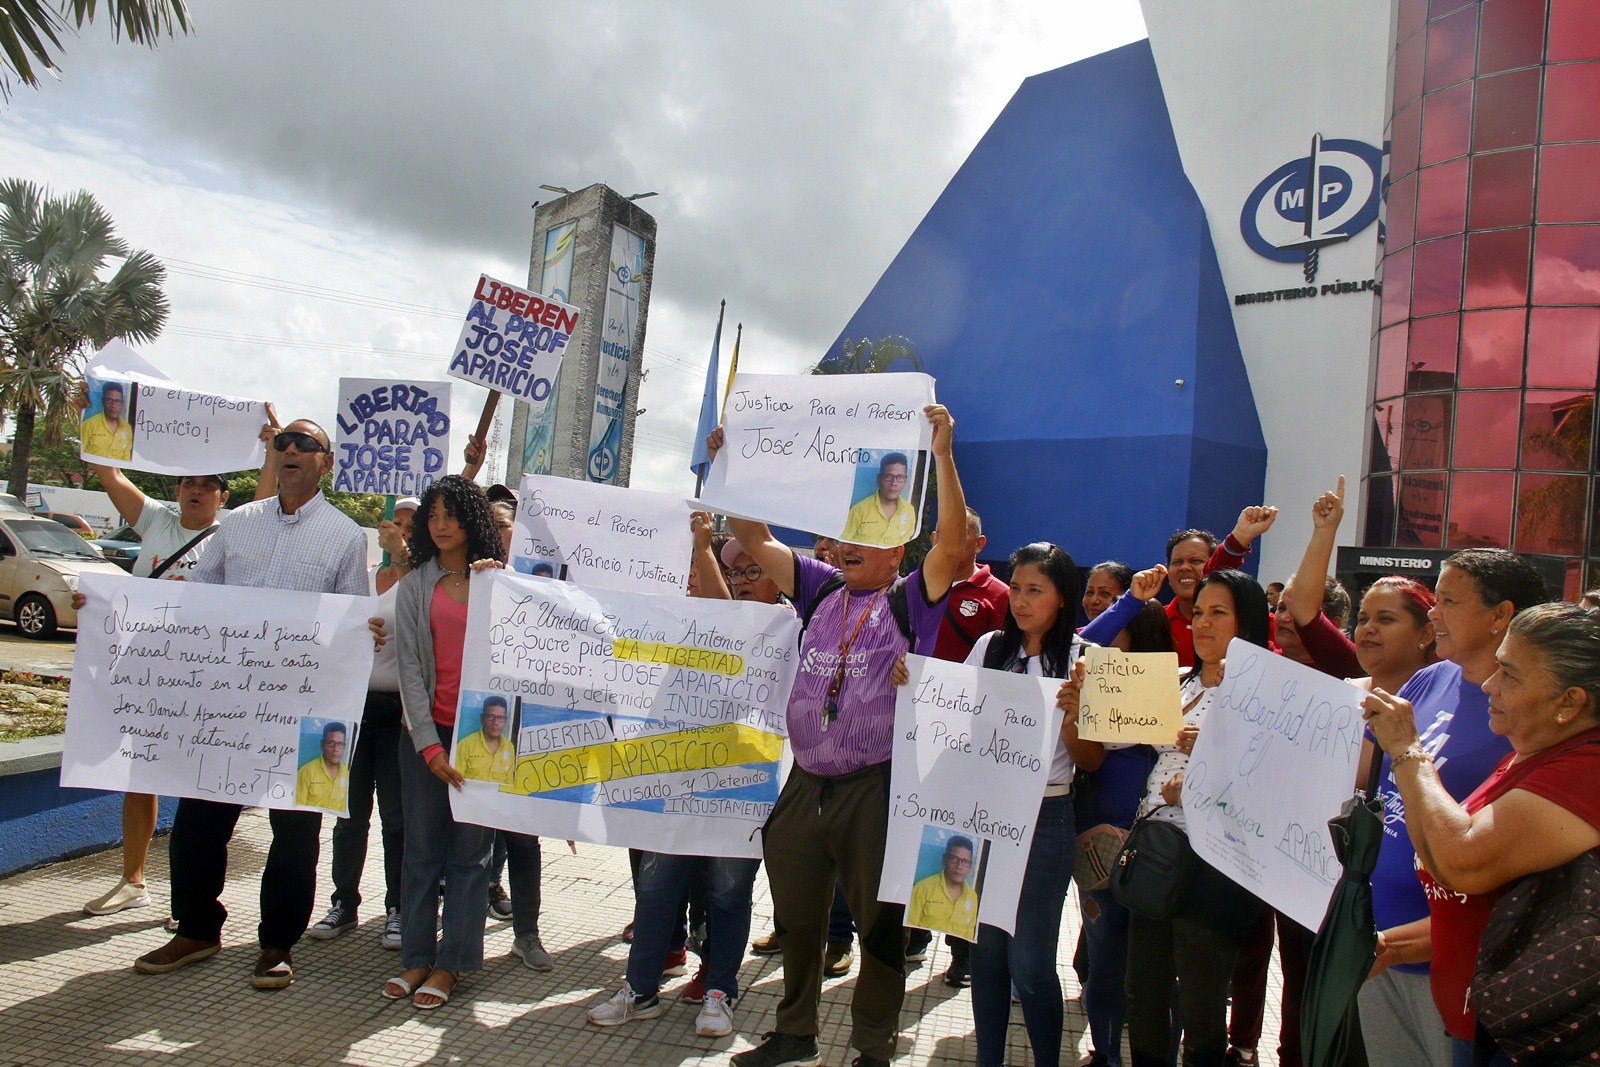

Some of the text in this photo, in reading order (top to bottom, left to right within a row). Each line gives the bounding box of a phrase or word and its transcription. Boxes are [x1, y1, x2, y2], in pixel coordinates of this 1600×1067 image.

[474, 277, 579, 335] LIBEREN
[1235, 279, 1376, 306] MINISTERIO PÚBLIC
[466, 301, 569, 353] AL PROF
[450, 349, 551, 401] APARICIO
[168, 386, 181, 401] el
[596, 383, 622, 403] Derechos
[735, 390, 916, 422] Justicia Para el Profesor
[336, 384, 451, 437] LIBERTAD
[596, 400, 622, 420] Humanos
[137, 408, 210, 444] Aparicio!
[364, 419, 429, 446] PARA
[741, 426, 799, 460] José
[423, 447, 444, 473] D
[334, 468, 435, 496] APARICIO
[611, 515, 659, 540] Profesor
[524, 537, 560, 557] José
[1359, 556, 1433, 569] MINISTERIO
[104, 595, 321, 651] Necesitamos que el fiscal
[500, 594, 528, 628] La
[538, 601, 590, 634] Unidad
[750, 633, 792, 663] José
[109, 640, 320, 670] general revise tome cartas
[489, 624, 520, 646] De
[579, 638, 614, 667] pide
[617, 643, 643, 662] LA
[650, 645, 744, 677] LIBERTAD
[746, 664, 780, 684] para
[1085, 653, 1146, 677] Justicia
[110, 668, 316, 694] en el asunto en el caso de
[491, 649, 506, 665] el
[602, 658, 663, 687] JOSÉ
[668, 668, 771, 704] APARICIO
[1096, 677, 1122, 694] Para
[148, 697, 190, 720] Daniel
[192, 701, 247, 726] Aparicio
[488, 675, 785, 733] acusado y detenido INJUSTAMENTE
[912, 675, 1037, 728] Libertad Para
[119, 723, 170, 741] acusado
[177, 733, 185, 747] y
[192, 726, 252, 751] detenido
[621, 721, 654, 741] para
[658, 716, 670, 730] el
[905, 724, 919, 741] el
[930, 720, 972, 754] Profe
[1307, 700, 1361, 764] PARA
[120, 743, 161, 763] mente
[517, 740, 730, 795] JOSÉ APARICIO
[592, 770, 768, 804] Acusado y Detenido
[1185, 761, 1264, 838] Profesor
[664, 798, 775, 818] INJUSTAMENTE
